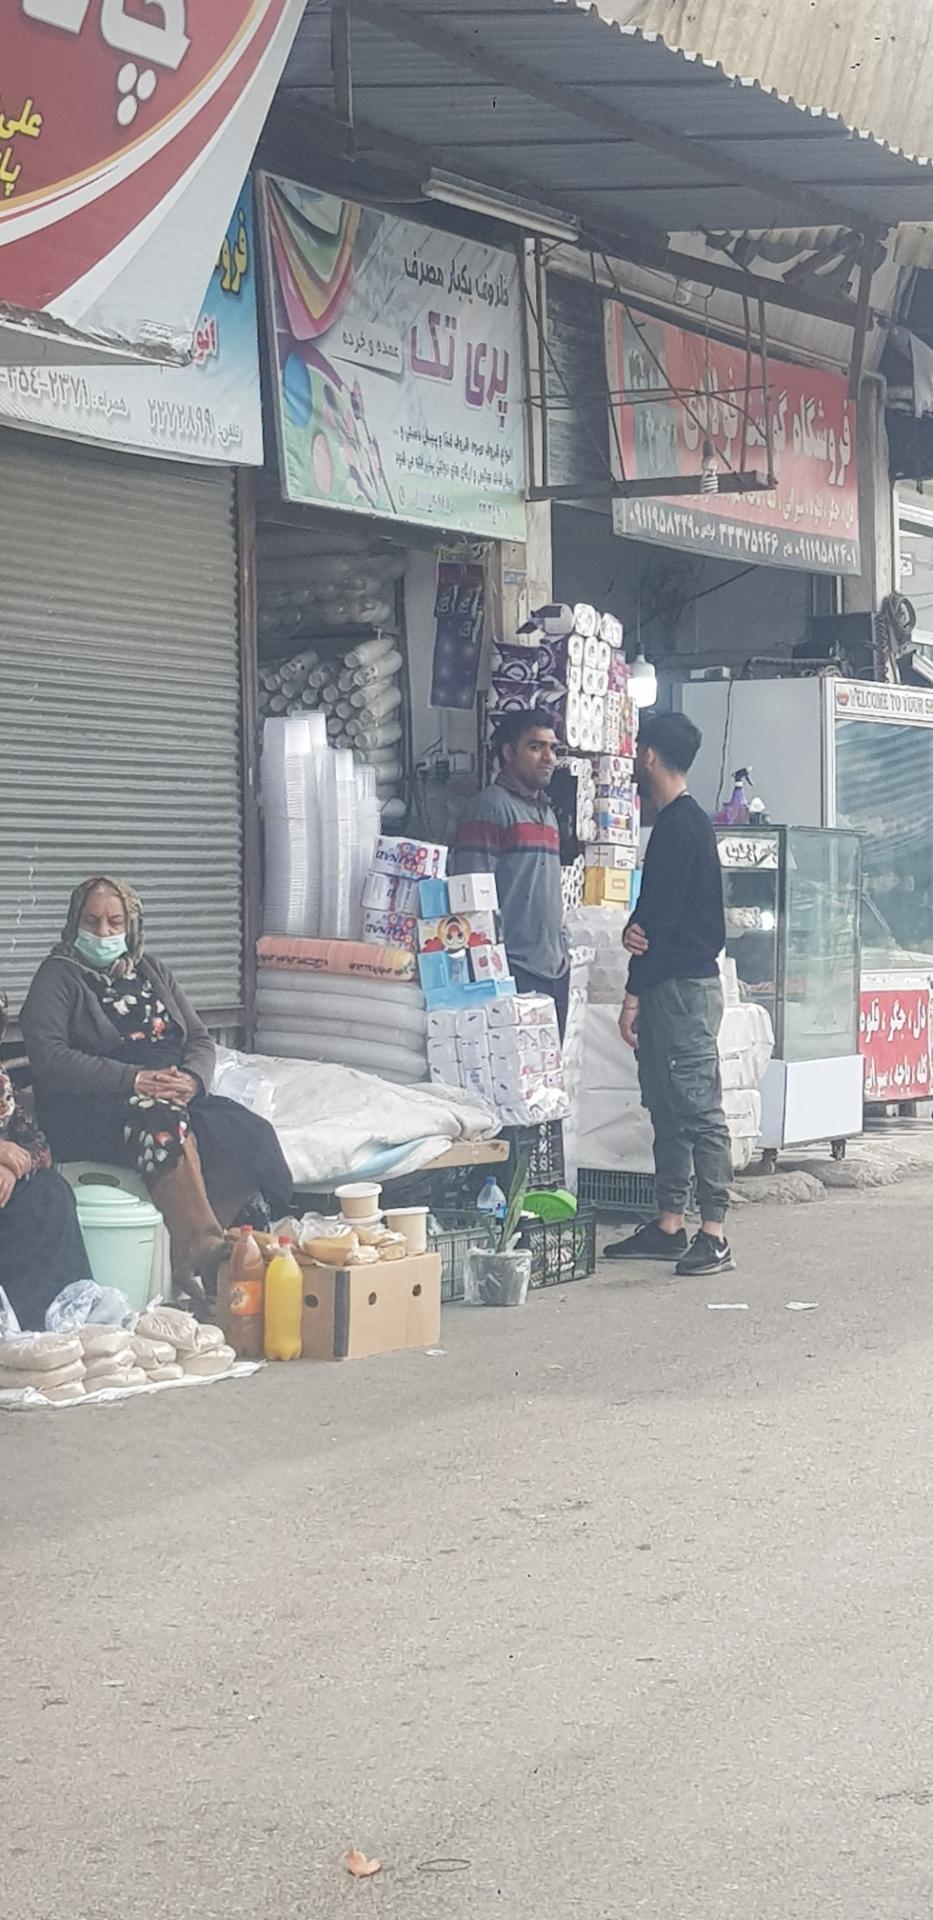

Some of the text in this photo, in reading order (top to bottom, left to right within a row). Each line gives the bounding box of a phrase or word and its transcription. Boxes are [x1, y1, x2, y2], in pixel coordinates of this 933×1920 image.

[404, 251, 509, 308] ظروف یکبار مصرف
[342, 331, 366, 354] خرده
[377, 340, 399, 358] عمده
[411, 311, 509, 428] پری تک
[793, 392, 852, 487] فروشگاه
[849, 687, 889, 710] WELCOME
[890, 692, 902, 711] TO
[902, 696, 924, 714] YOUR
